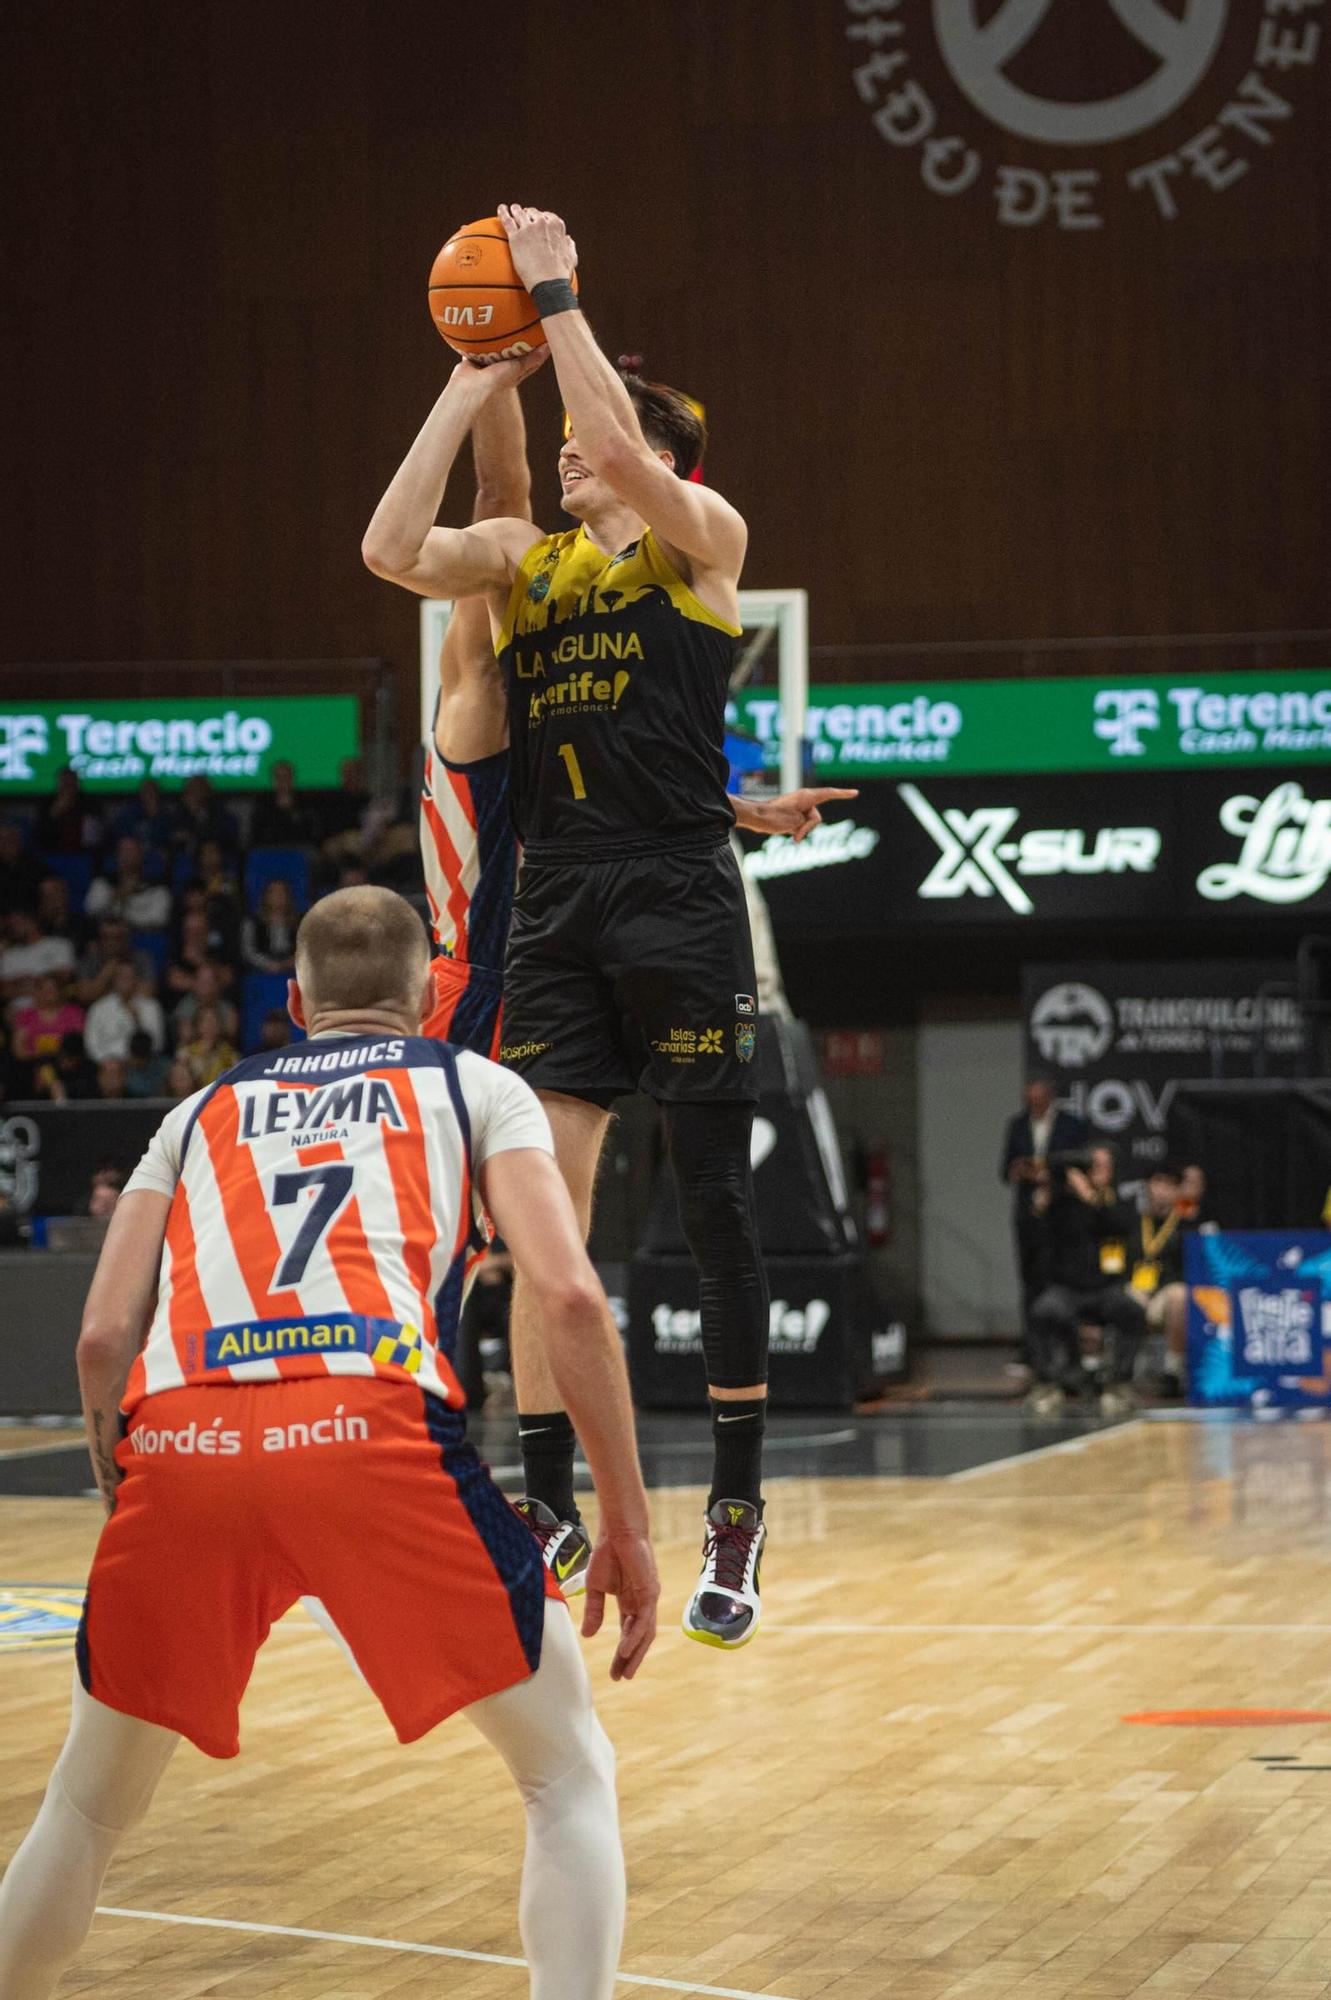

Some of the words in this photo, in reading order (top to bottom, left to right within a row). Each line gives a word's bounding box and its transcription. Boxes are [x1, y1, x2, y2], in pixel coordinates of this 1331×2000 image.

[845, 0, 982, 196] ILDO
[996, 166, 1102, 230] DE
[1127, 0, 1325, 221] TENE
[443, 304, 495, 326] EVO
[553, 631, 644, 665] GUNA
[56, 711, 273, 754] Terencio
[745, 695, 963, 741] Trencio
[838, 739, 951, 765] Market
[1179, 728, 1258, 756] Cash
[150, 752, 261, 778] Market
[558, 743, 588, 800] 1
[897, 782, 1161, 916] X-SUR
[500, 1041, 554, 1060] Hospite
[651, 1039, 697, 1054] Canarias
[670, 1028, 697, 1041] Islas
[241, 1079, 405, 1141] LEYMA
[291, 1127, 349, 1148] NATURA
[271, 1164, 354, 1288] 7
[217, 1321, 356, 1360] Aluman
[262, 1404, 369, 1452] ancín
